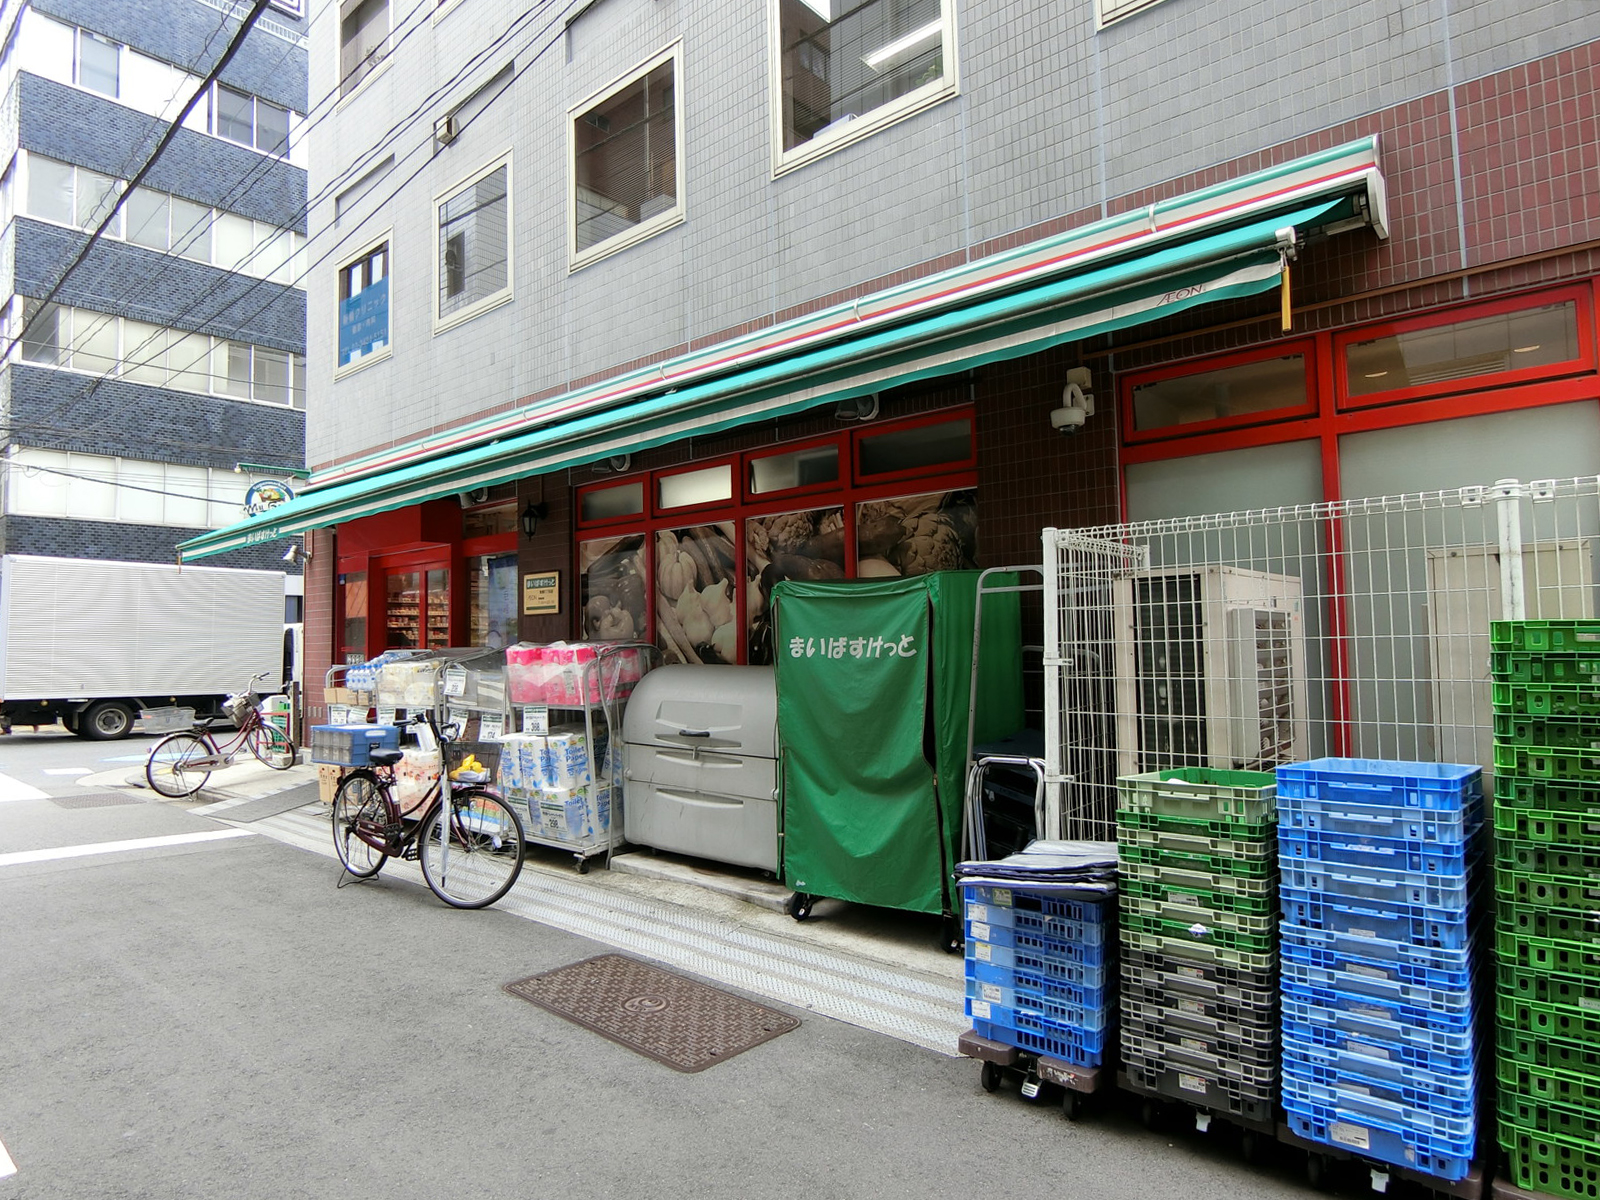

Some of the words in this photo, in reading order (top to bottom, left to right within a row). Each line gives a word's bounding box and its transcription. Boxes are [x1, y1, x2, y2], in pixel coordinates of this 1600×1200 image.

[247, 528, 278, 544] まいばすけっと
[789, 634, 918, 659] まいばすけっと
[564, 745, 585, 755] Toilet
[565, 753, 587, 762] Paper
